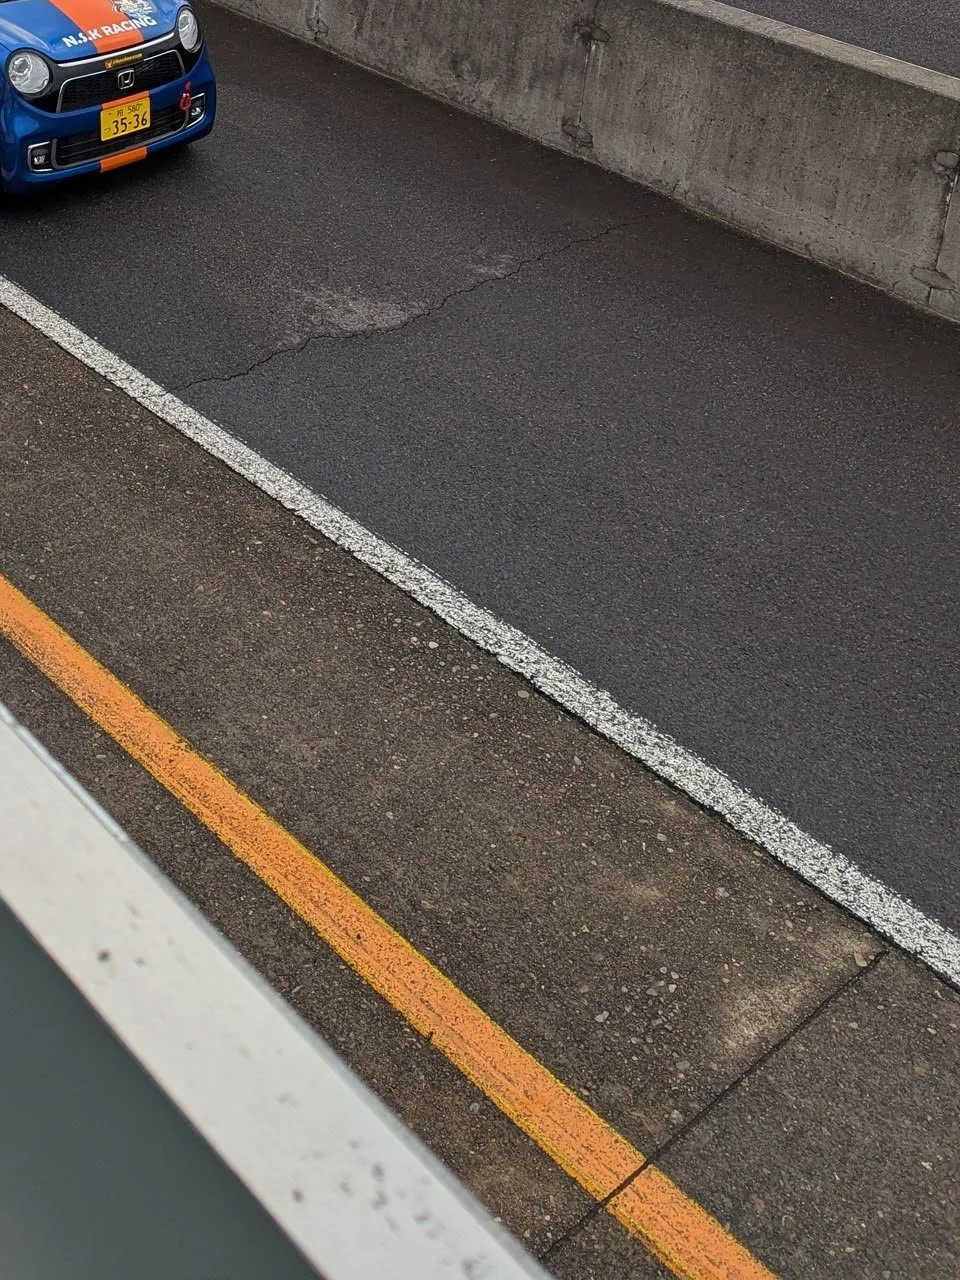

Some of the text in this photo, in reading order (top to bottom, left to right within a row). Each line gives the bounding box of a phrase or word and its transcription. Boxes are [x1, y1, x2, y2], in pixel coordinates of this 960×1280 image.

[62, 17, 157, 47] N.S.K RACING
[112, 111, 147, 135] 35-36
